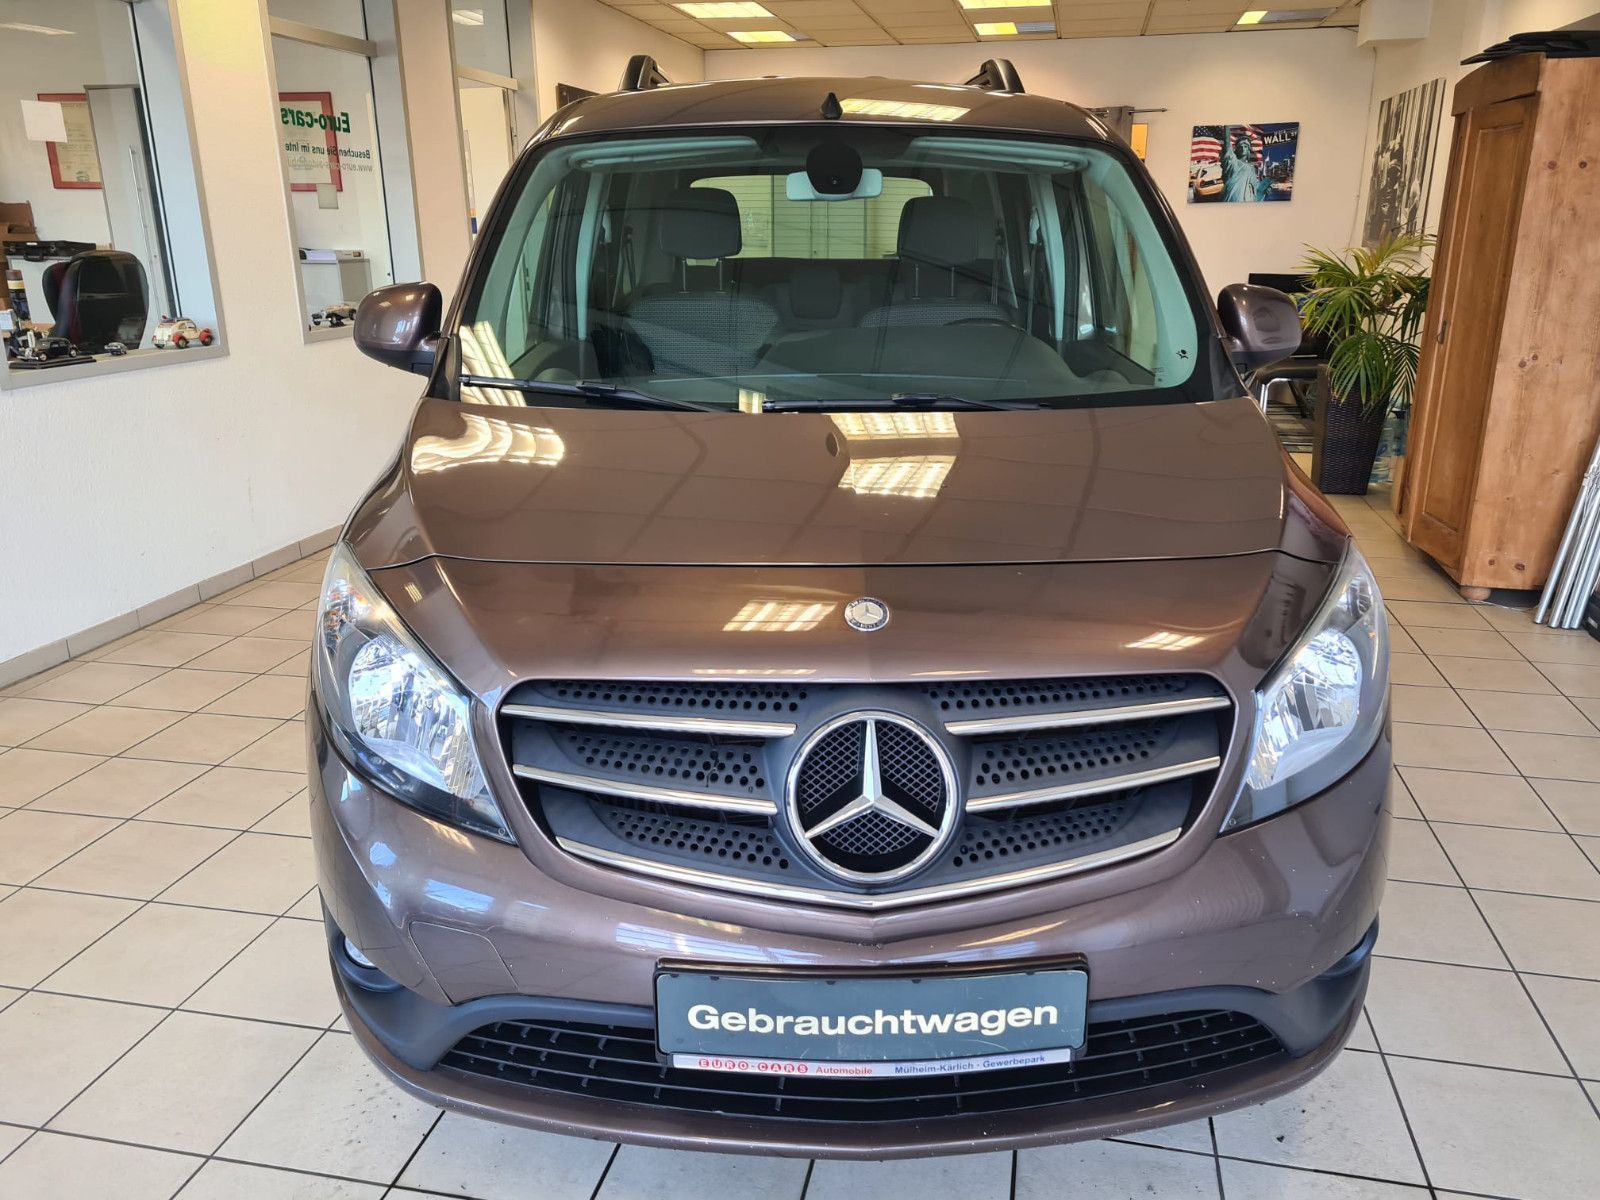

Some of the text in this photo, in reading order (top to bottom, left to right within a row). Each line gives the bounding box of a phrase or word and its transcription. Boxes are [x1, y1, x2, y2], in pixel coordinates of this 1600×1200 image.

[1263, 132, 1291, 145] WALL
[687, 1004, 1058, 1036] Gebrauchtwagen
[816, 1065, 873, 1076] Automobile
[894, 1062, 974, 1075] Mülheim-Kärlich
[983, 1055, 1046, 1069] Gewerbepark
